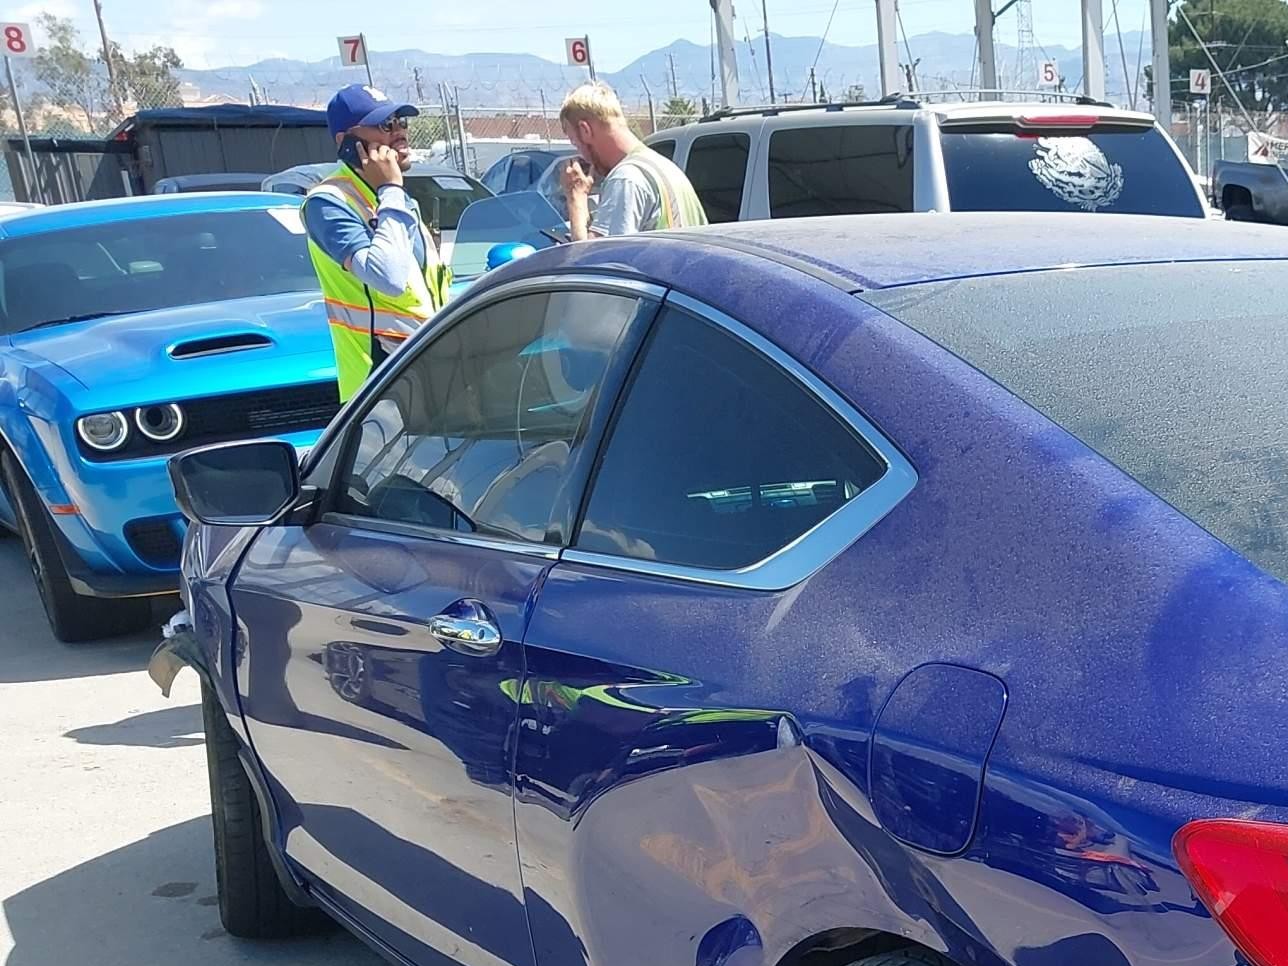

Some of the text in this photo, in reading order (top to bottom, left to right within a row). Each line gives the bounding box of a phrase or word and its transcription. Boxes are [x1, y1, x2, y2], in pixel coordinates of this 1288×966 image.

[4, 26, 26, 53] 8
[343, 39, 360, 62] 7
[572, 41, 586, 63] 6
[1044, 63, 1054, 82] 5
[1195, 72, 1206, 90] 4
